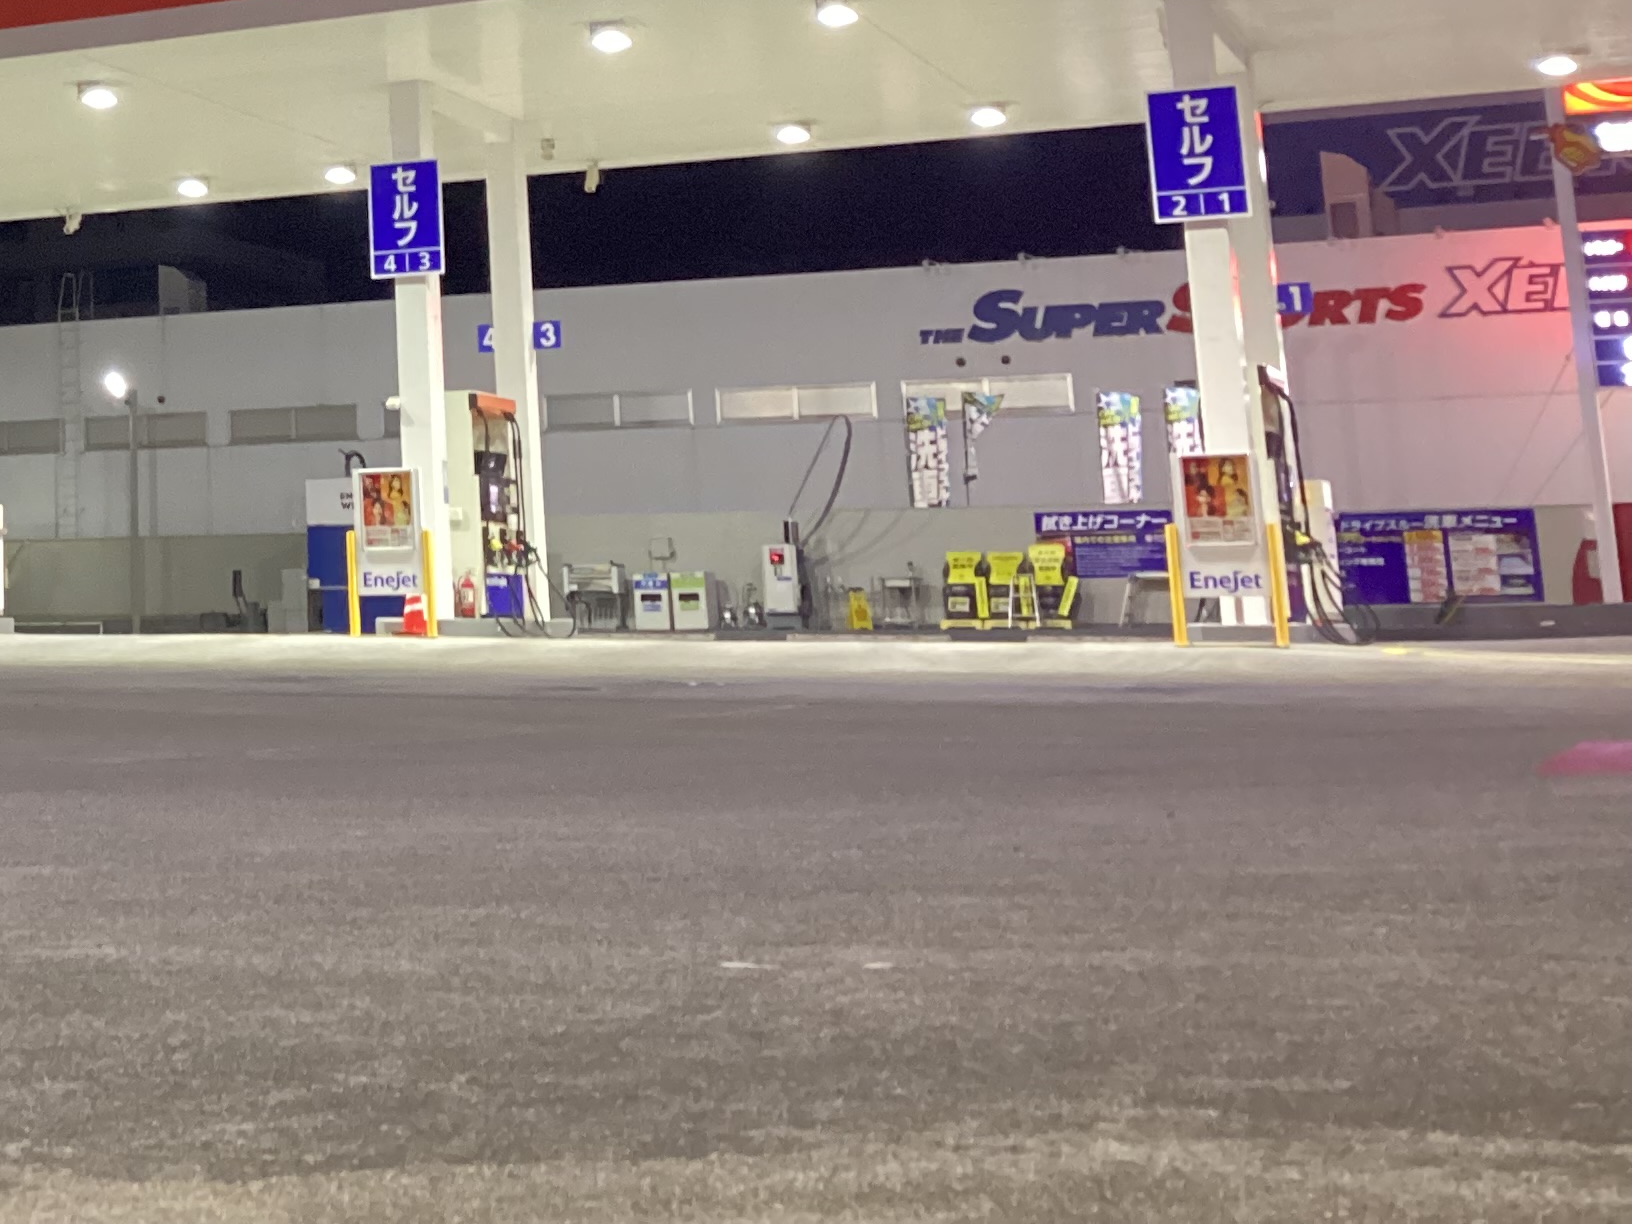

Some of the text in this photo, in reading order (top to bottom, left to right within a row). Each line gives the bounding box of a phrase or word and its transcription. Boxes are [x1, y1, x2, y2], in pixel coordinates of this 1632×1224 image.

[1175, 94, 1214, 186] セルフ
[391, 166, 419, 247] セルフ
[1171, 192, 1230, 216] 2 1
[383, 251, 431, 272] 4 3
[919, 328, 965, 345] THE
[967, 289, 1166, 343] SUPER
[1437, 256, 1571, 319] XE
[539, 322, 557, 348] 3
